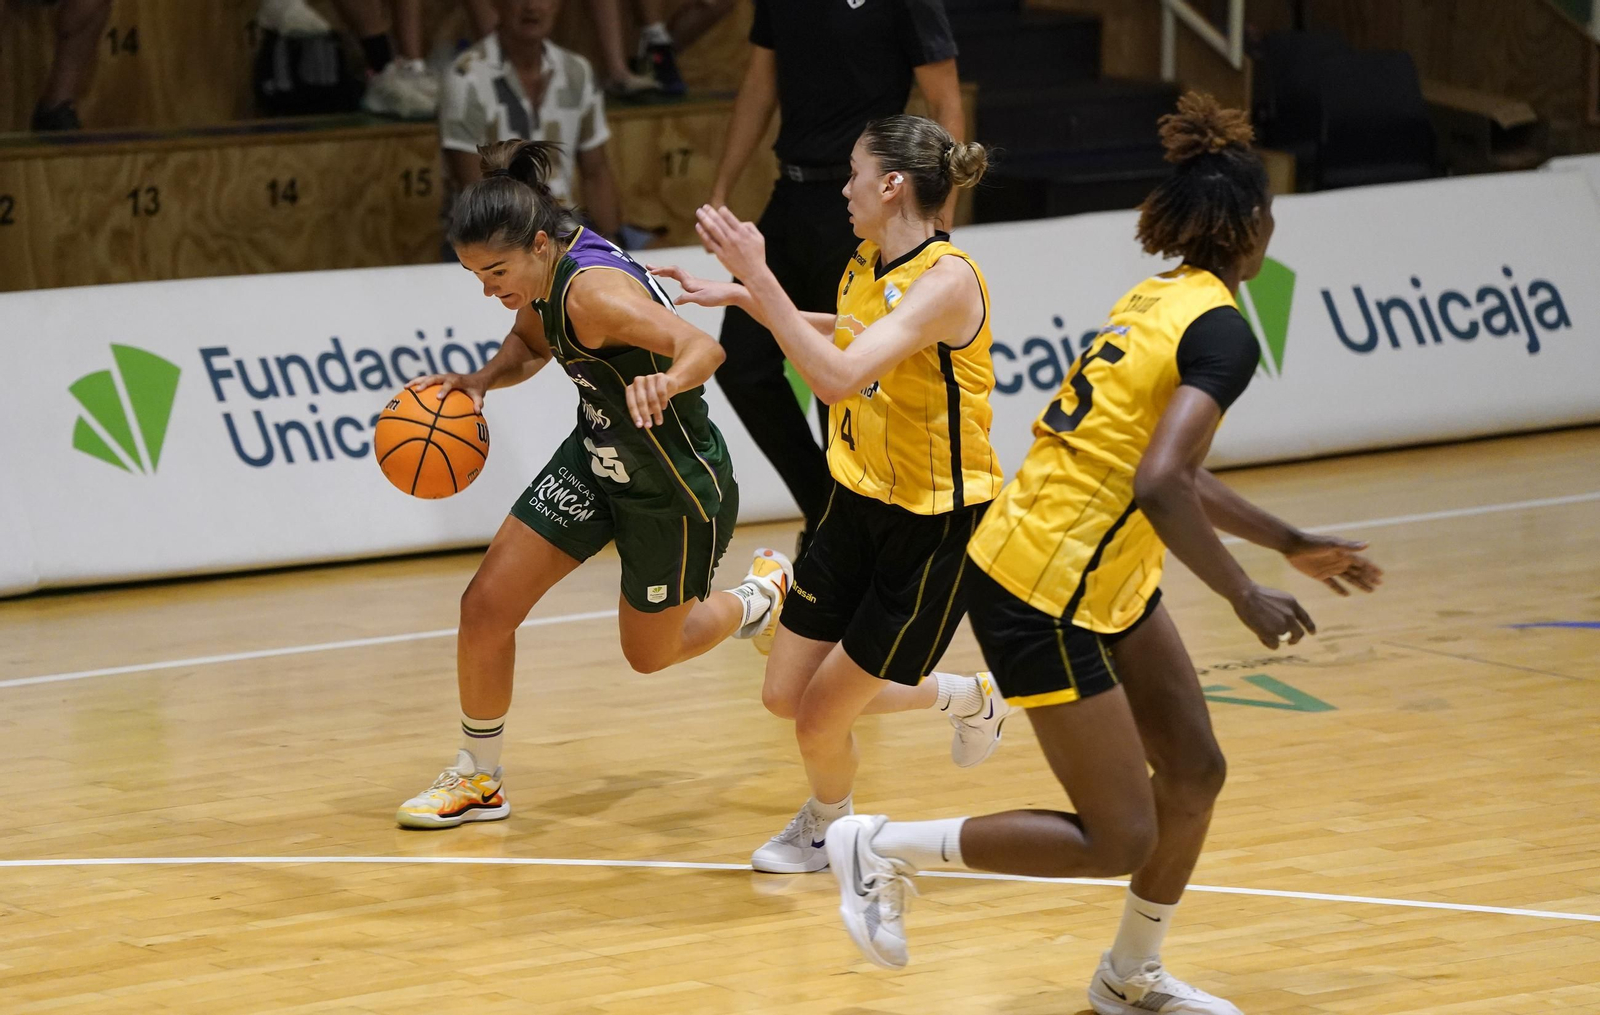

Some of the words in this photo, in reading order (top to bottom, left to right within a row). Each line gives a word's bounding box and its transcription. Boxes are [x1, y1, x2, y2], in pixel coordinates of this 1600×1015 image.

[108, 27, 139, 56] 14
[660, 147, 692, 176] 17
[267, 178, 298, 207] 14
[402, 168, 432, 197] 15
[0, 196, 15, 226] 2
[128, 186, 161, 217] 13
[1320, 265, 1572, 355] Unicaja
[223, 402, 376, 468] Unic
[558, 466, 595, 500] CLINICAS
[528, 496, 568, 528] DENTAL
